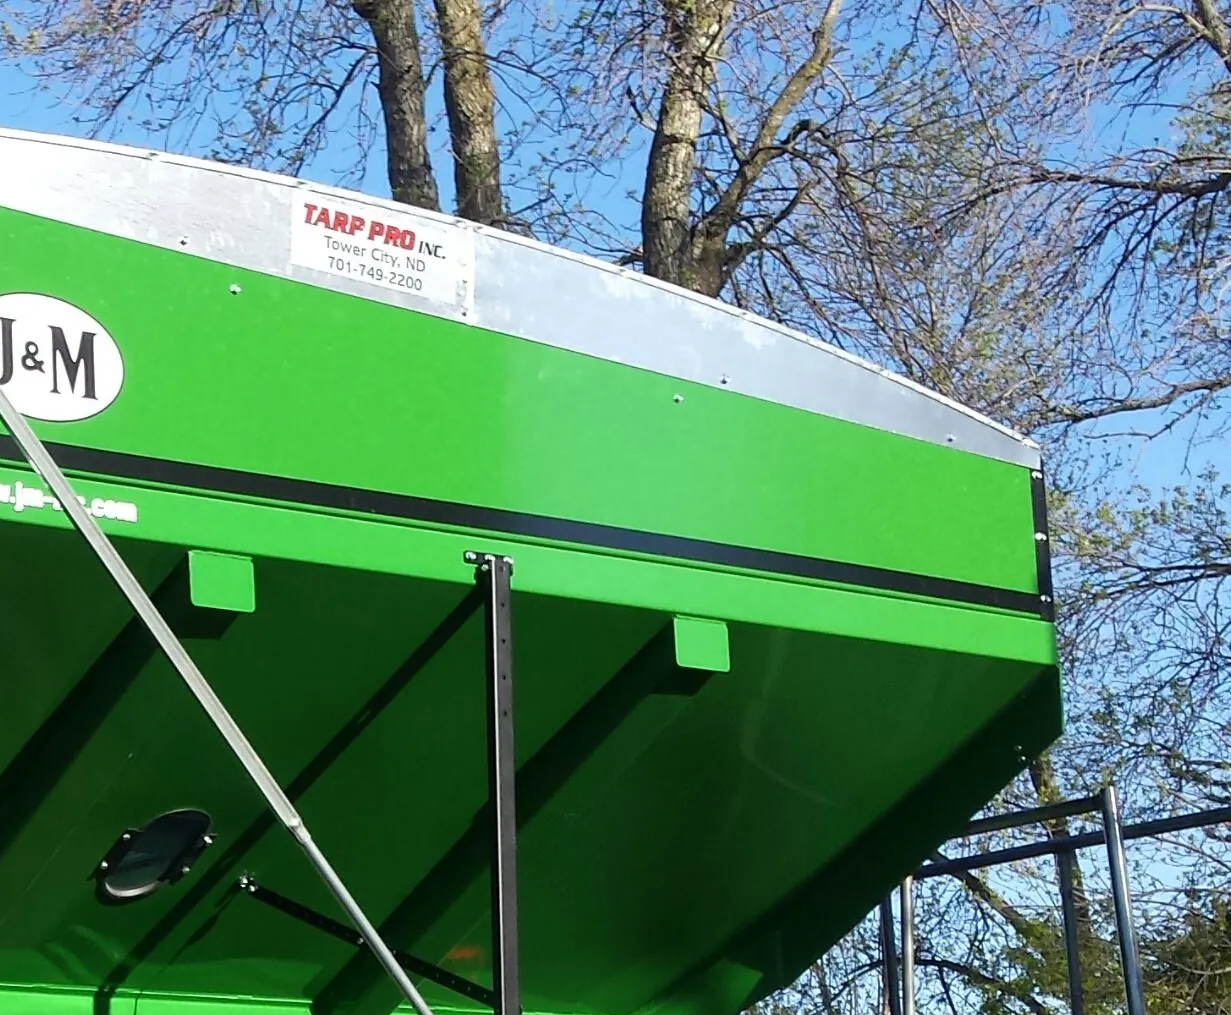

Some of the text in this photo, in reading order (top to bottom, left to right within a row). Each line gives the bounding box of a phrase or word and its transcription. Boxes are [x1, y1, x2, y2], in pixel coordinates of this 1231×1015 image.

[303, 203, 446, 260] TARP PRO INC.
[324, 235, 426, 273] Tower City, ND
[328, 256, 423, 291] 701-749-2200
